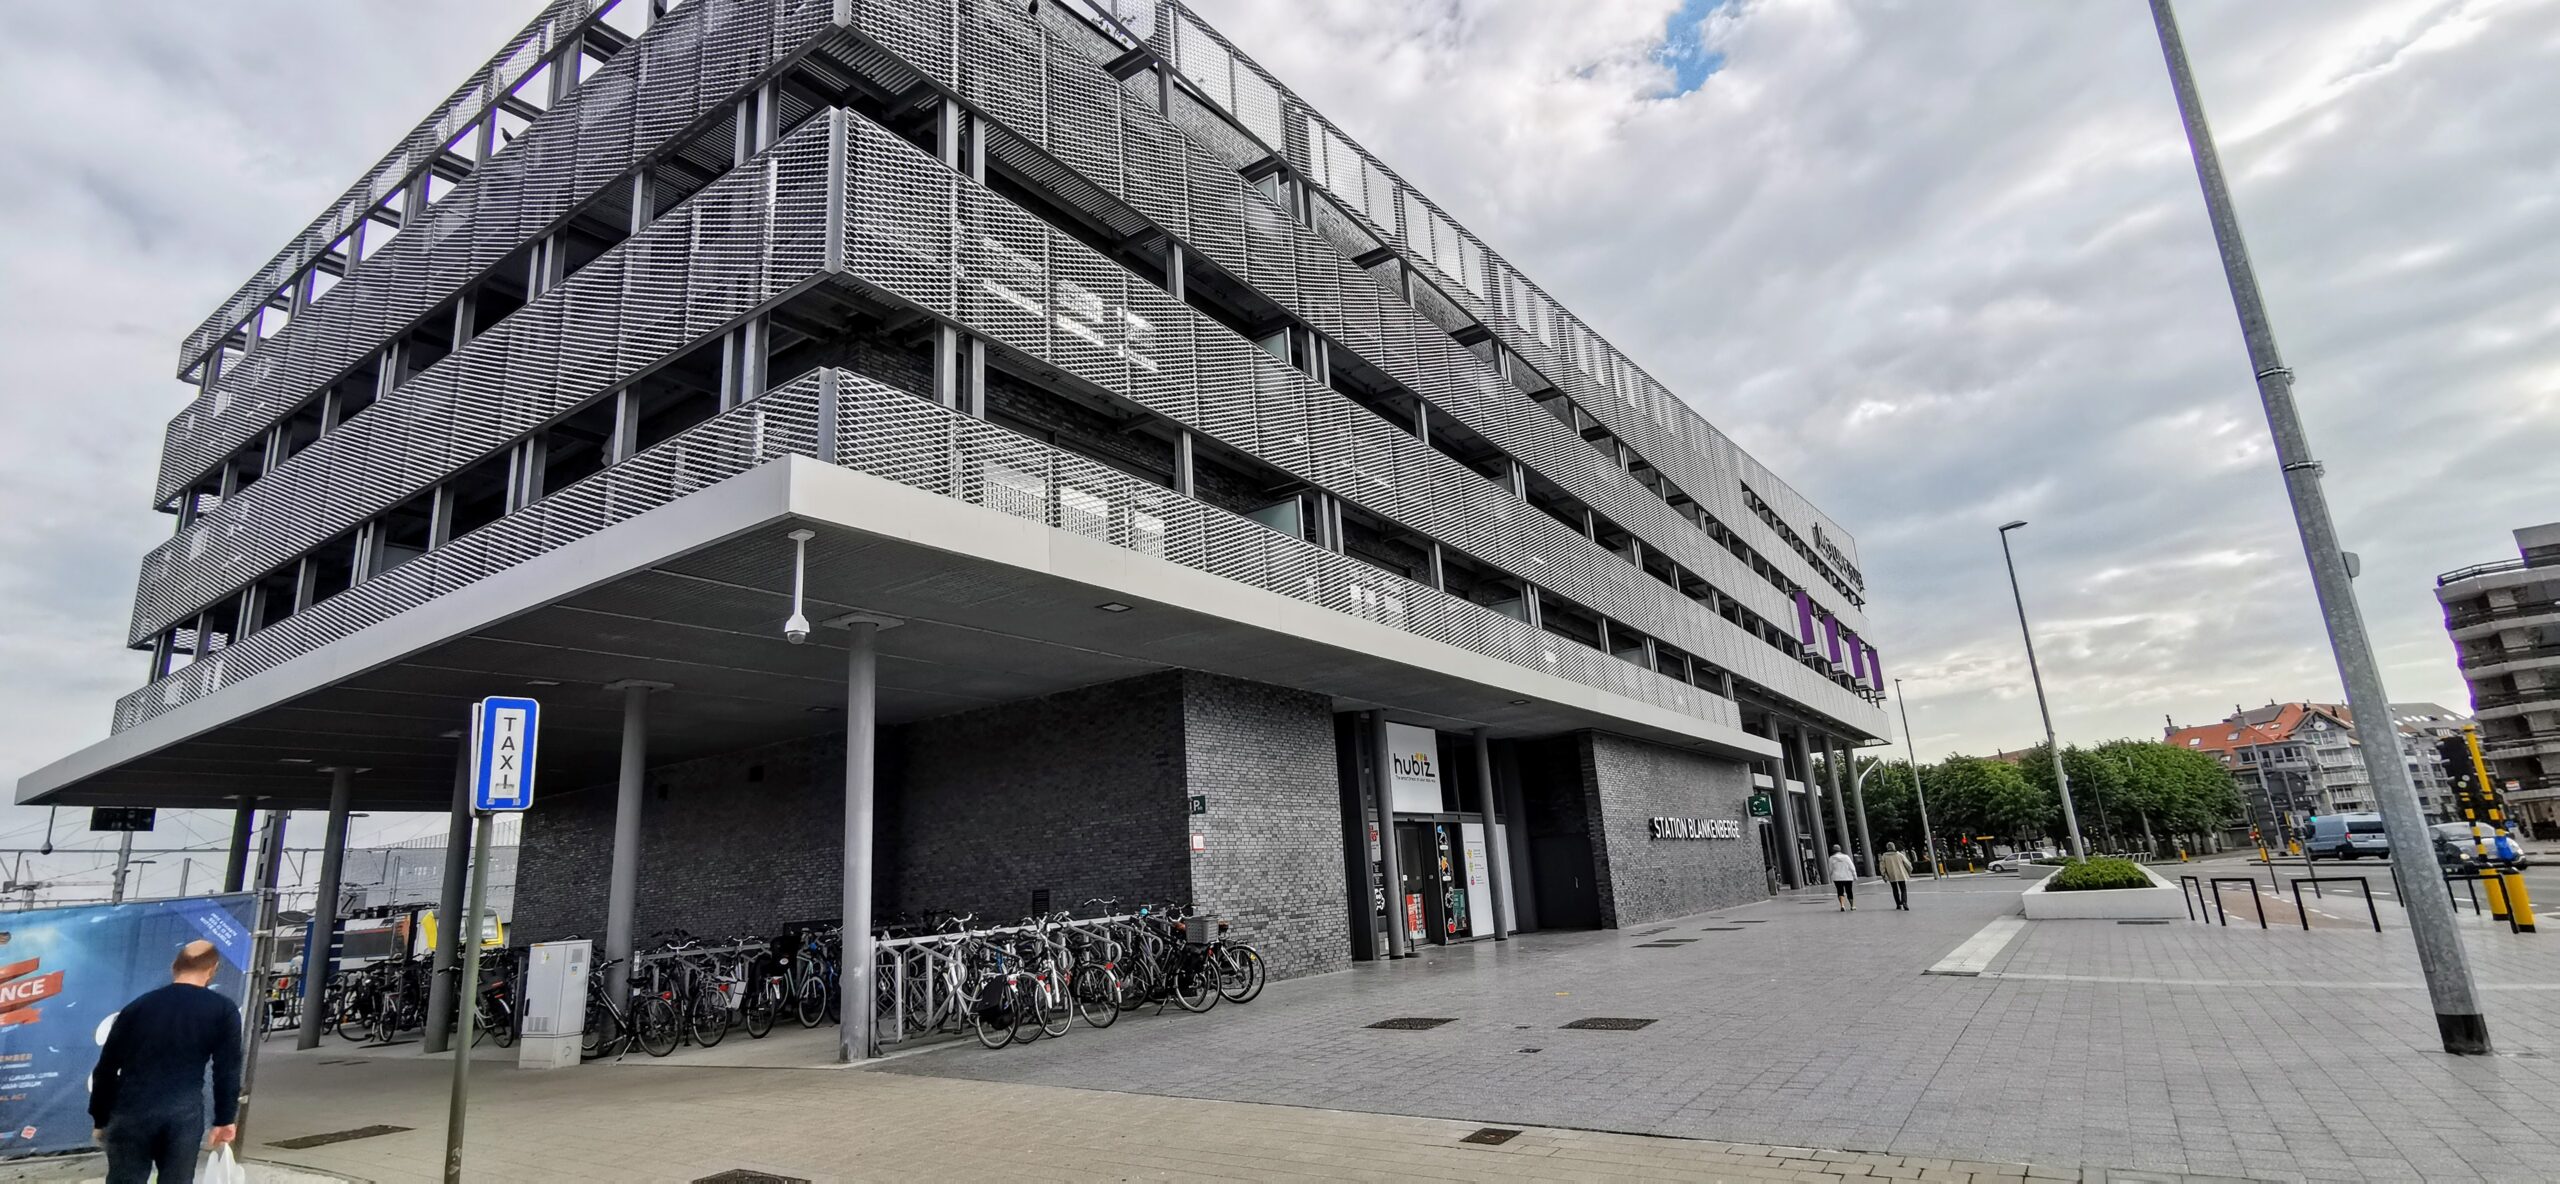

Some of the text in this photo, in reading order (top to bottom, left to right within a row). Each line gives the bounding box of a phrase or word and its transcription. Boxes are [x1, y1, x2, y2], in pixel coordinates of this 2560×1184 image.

[500, 717, 517, 789] TAXI
[1393, 753, 1436, 778] hubiz
[1653, 816, 1741, 839] STATION BLANKENBERGE
